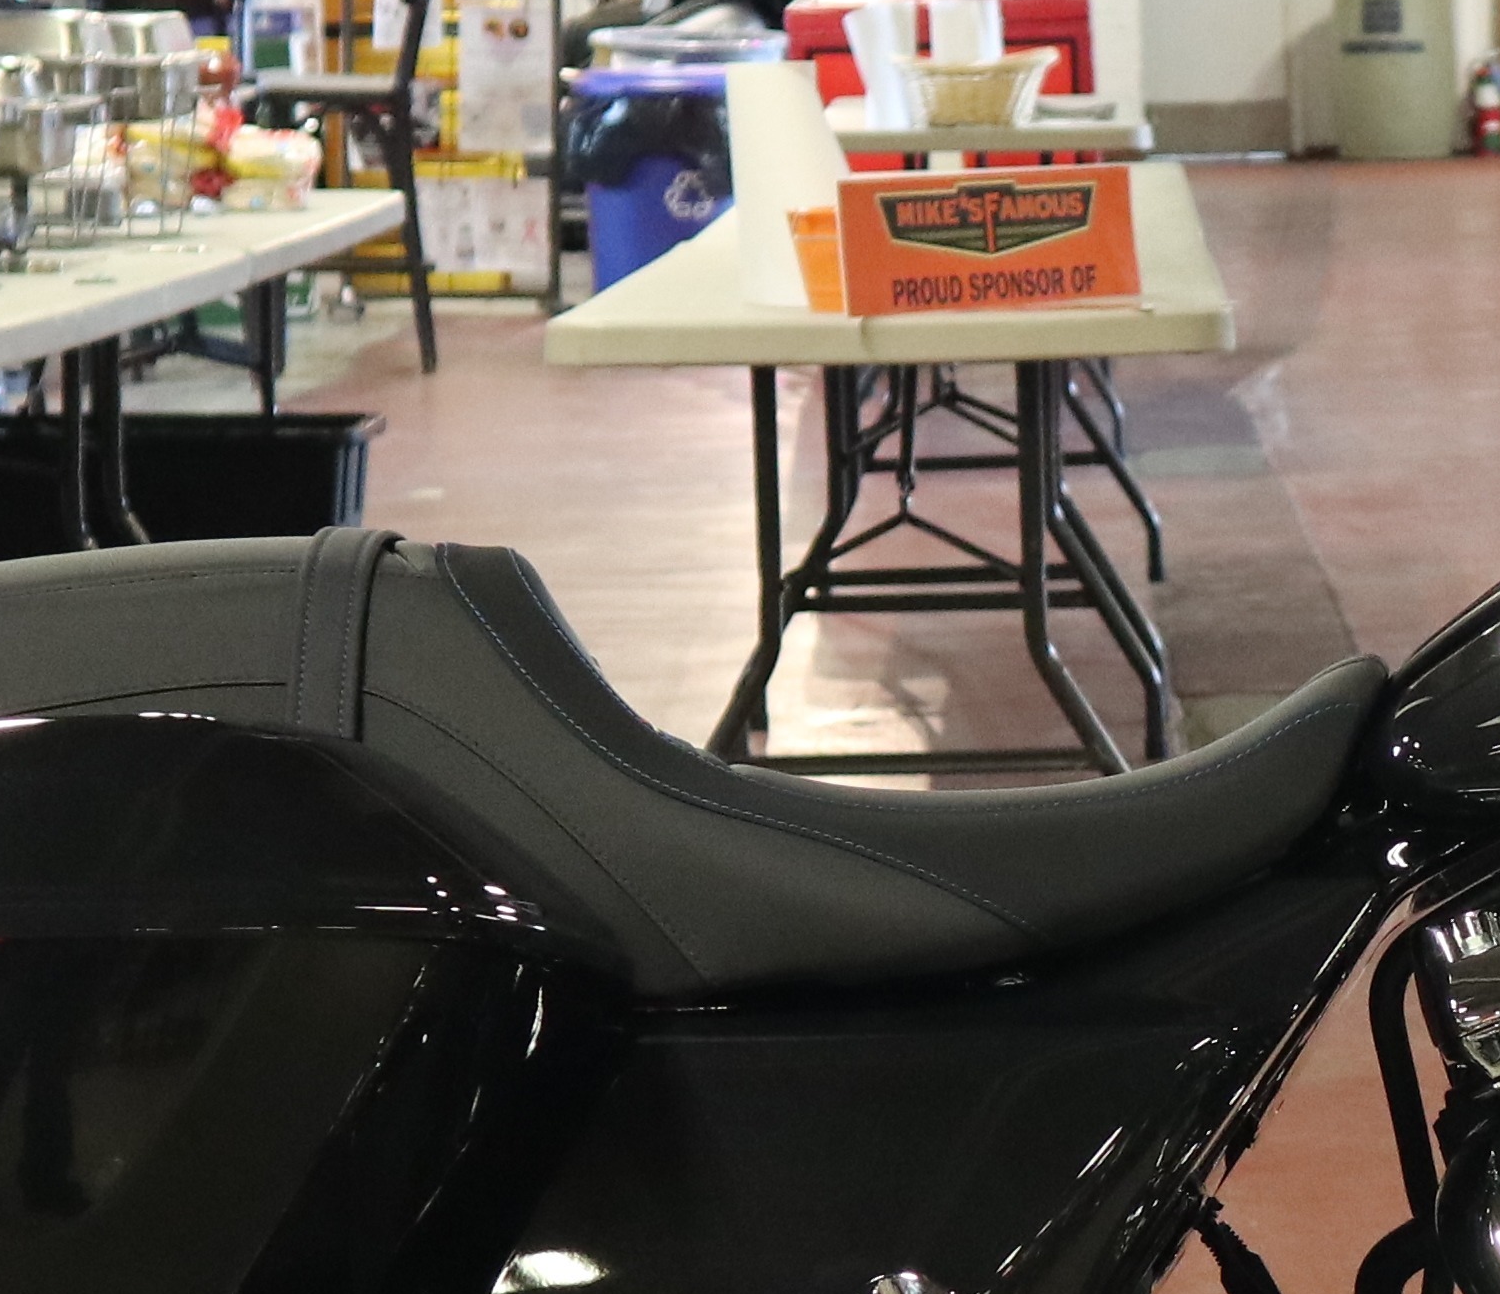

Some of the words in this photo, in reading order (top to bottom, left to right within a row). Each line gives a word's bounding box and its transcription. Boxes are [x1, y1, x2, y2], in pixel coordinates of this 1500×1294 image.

[895, 194, 984, 226] MIKE'S
[984, 191, 1086, 253] FAMOUS
[893, 274, 963, 306] PROUD
[969, 267, 1065, 301] SPONSOR
[1071, 264, 1097, 292] OF
